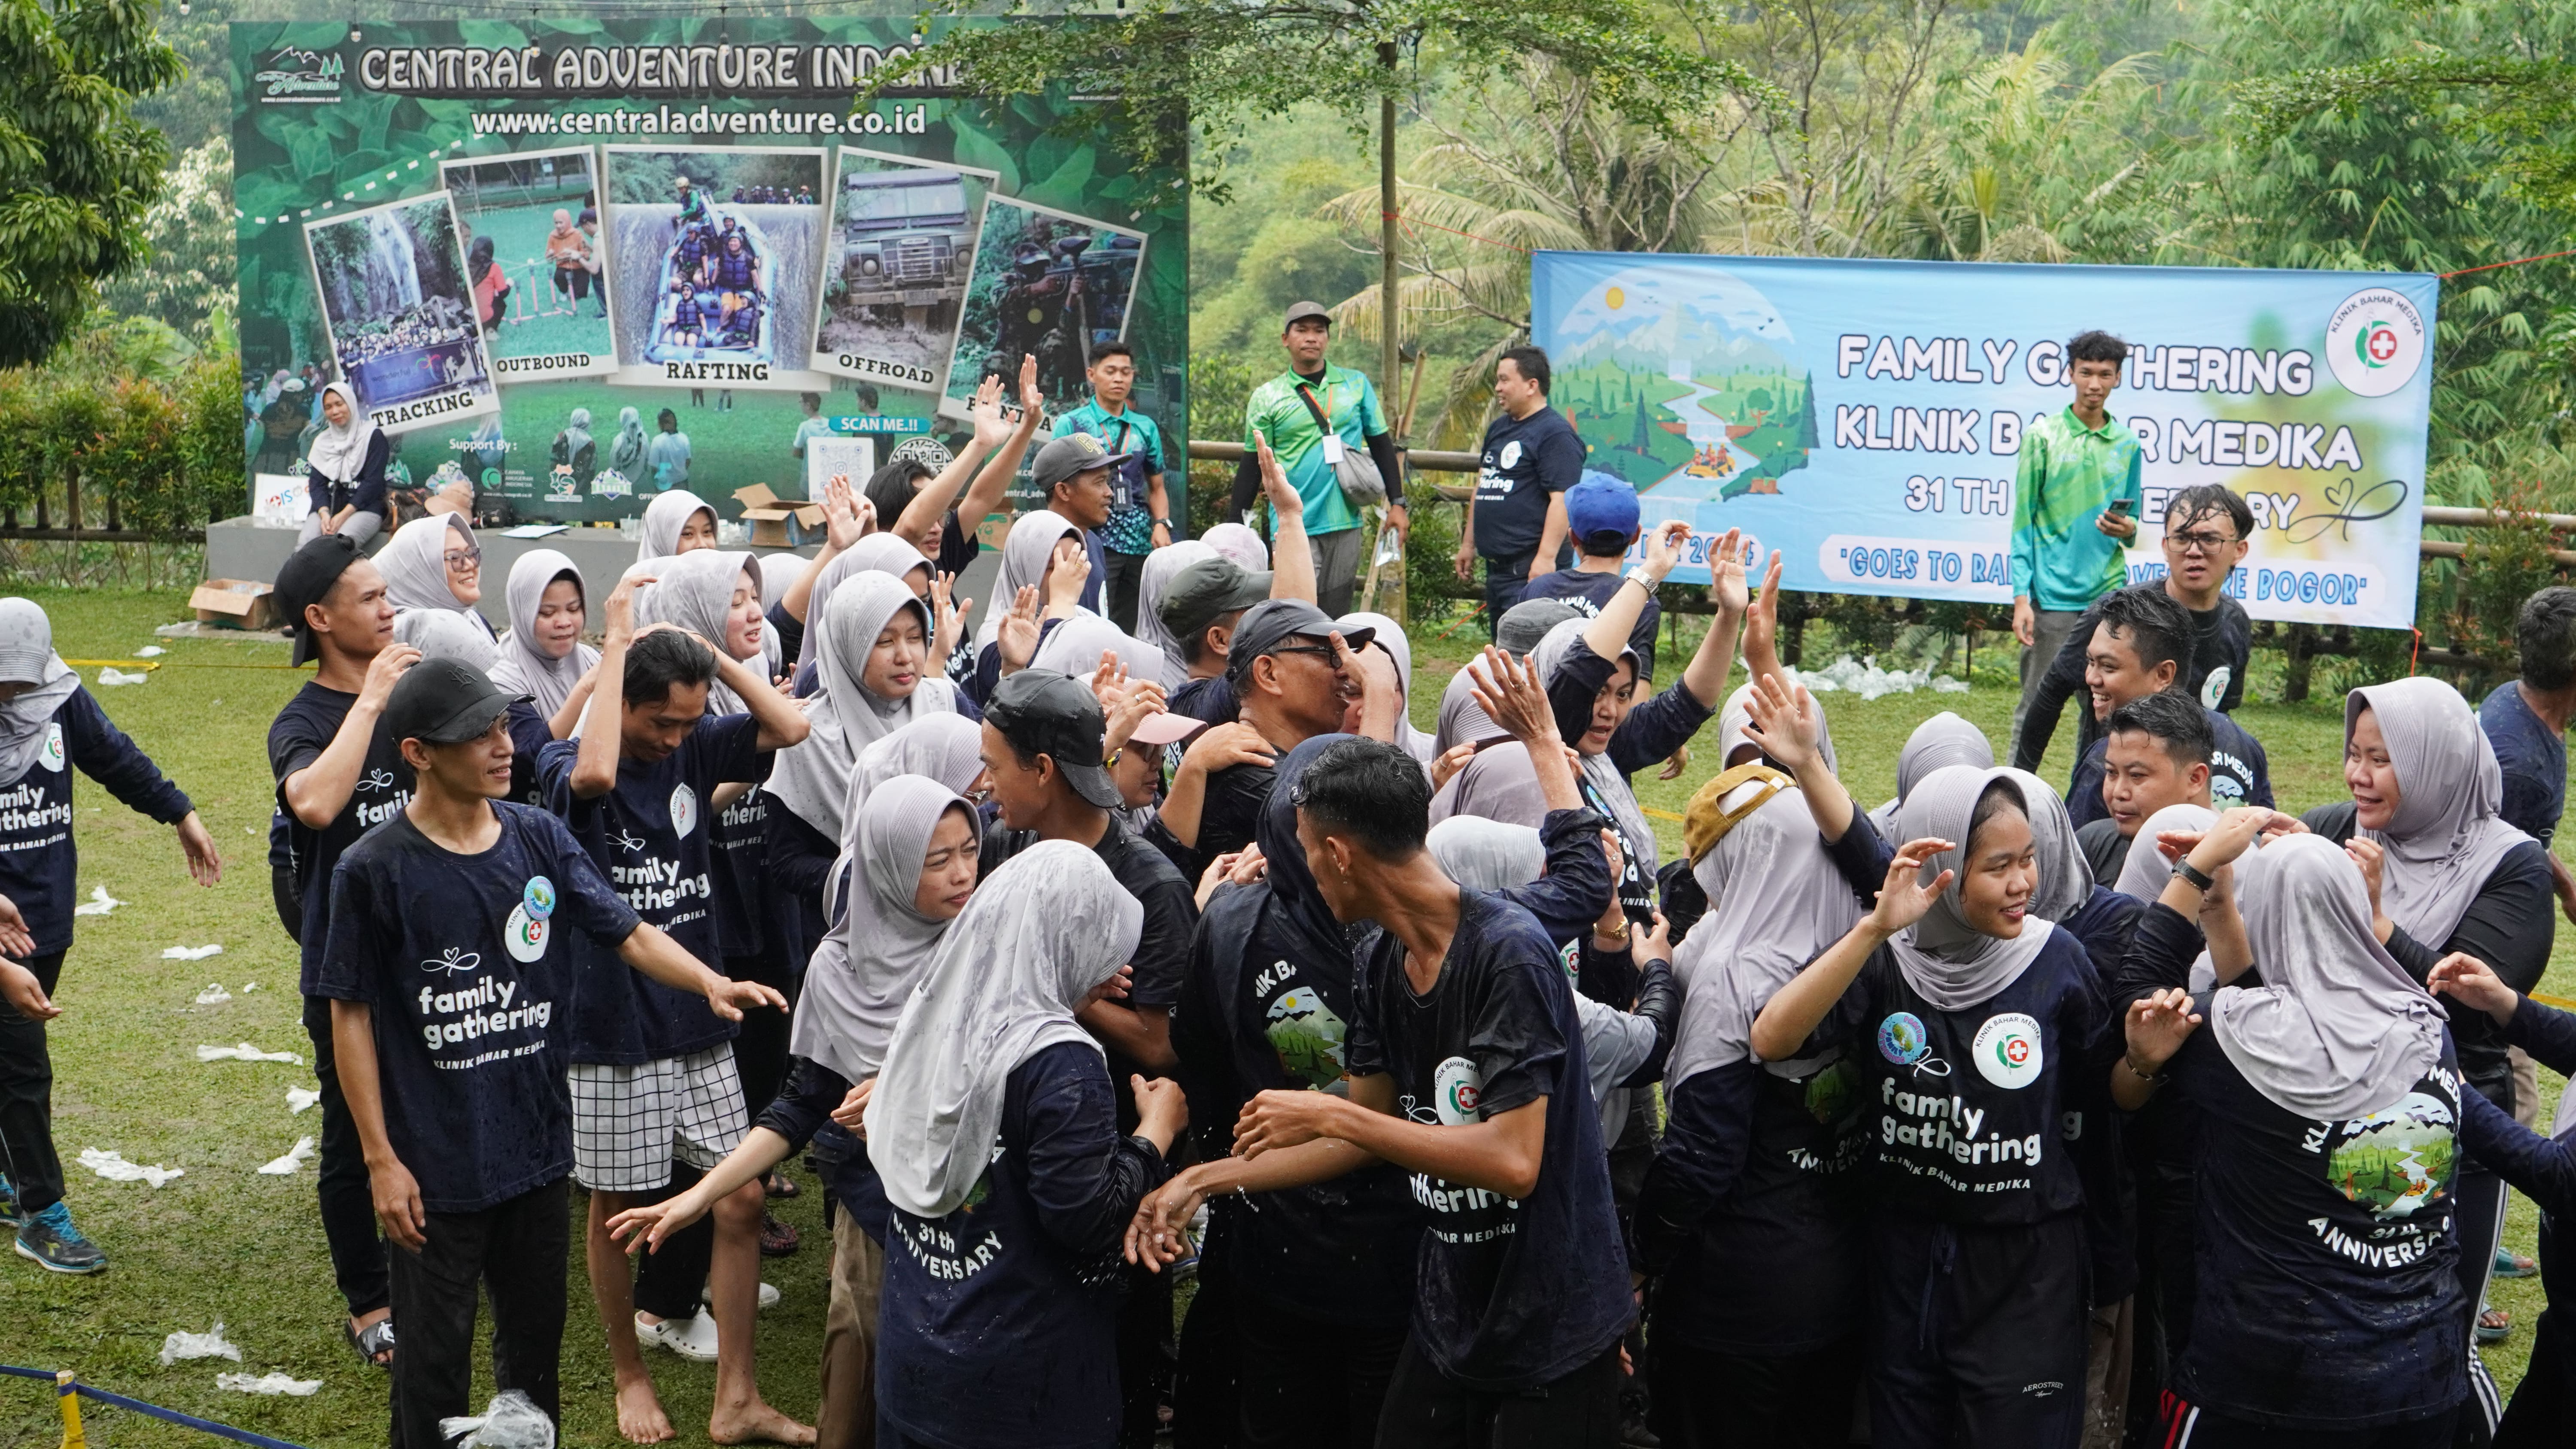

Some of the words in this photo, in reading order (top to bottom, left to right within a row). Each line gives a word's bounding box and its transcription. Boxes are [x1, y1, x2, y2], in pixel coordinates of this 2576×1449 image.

[360, 47, 542, 89] CENTRAL
[553, 46, 799, 89] ADVENTURE
[471, 105, 926, 135] www.centraladventure.co.id
[2331, 301, 2358, 333] KLINIK
[2360, 295, 2394, 306] BAHAR
[2395, 301, 2421, 336] MEDIKA
[497, 354, 590, 373] OUTBOUND
[666, 362, 769, 380] RAFTING
[839, 354, 934, 384] OFFROAD
[1838, 334, 2017, 385] FAMILY
[371, 391, 474, 427] TRACKING
[841, 417, 882, 431] SCAN
[884, 417, 918, 432] ME.!!
[1834, 403, 1980, 455] KLINIK
[449, 438, 494, 452] Support
[496, 439, 510, 453] By
[2169, 417, 2363, 472] MEDIKA
[1905, 475, 1944, 512] 31
[1953, 477, 2009, 515] TH
[1928, 550, 1962, 582] TO
[0, 783, 45, 809] mily
[0, 801, 71, 831] thering
[13, 839, 46, 851] BAHAR
[611, 857, 680, 886] amily
[507, 909, 522, 929] KLINIK
[418, 975, 516, 1015] family
[423, 1000, 552, 1050] gathering
[1975, 1024, 1993, 1048] KLINIK
[1993, 1016, 2019, 1026] BAHAR
[2021, 1018, 2041, 1041] MEDIKA
[434, 1058, 474, 1070] KLINIK
[476, 1049, 509, 1066] BAHAR
[1445, 1060, 1465, 1070] BAHAR
[1882, 1115, 2041, 1167] gathering
[1880, 1152, 1923, 1176] KLINIK
[1927, 1166, 1968, 1192] BAHAR
[1974, 1179, 2031, 1193] MEDIKA
[919, 1222, 935, 1246] 31
[939, 1231, 955, 1253] th
[2022, 1382, 2064, 1394] AEROSTREET
